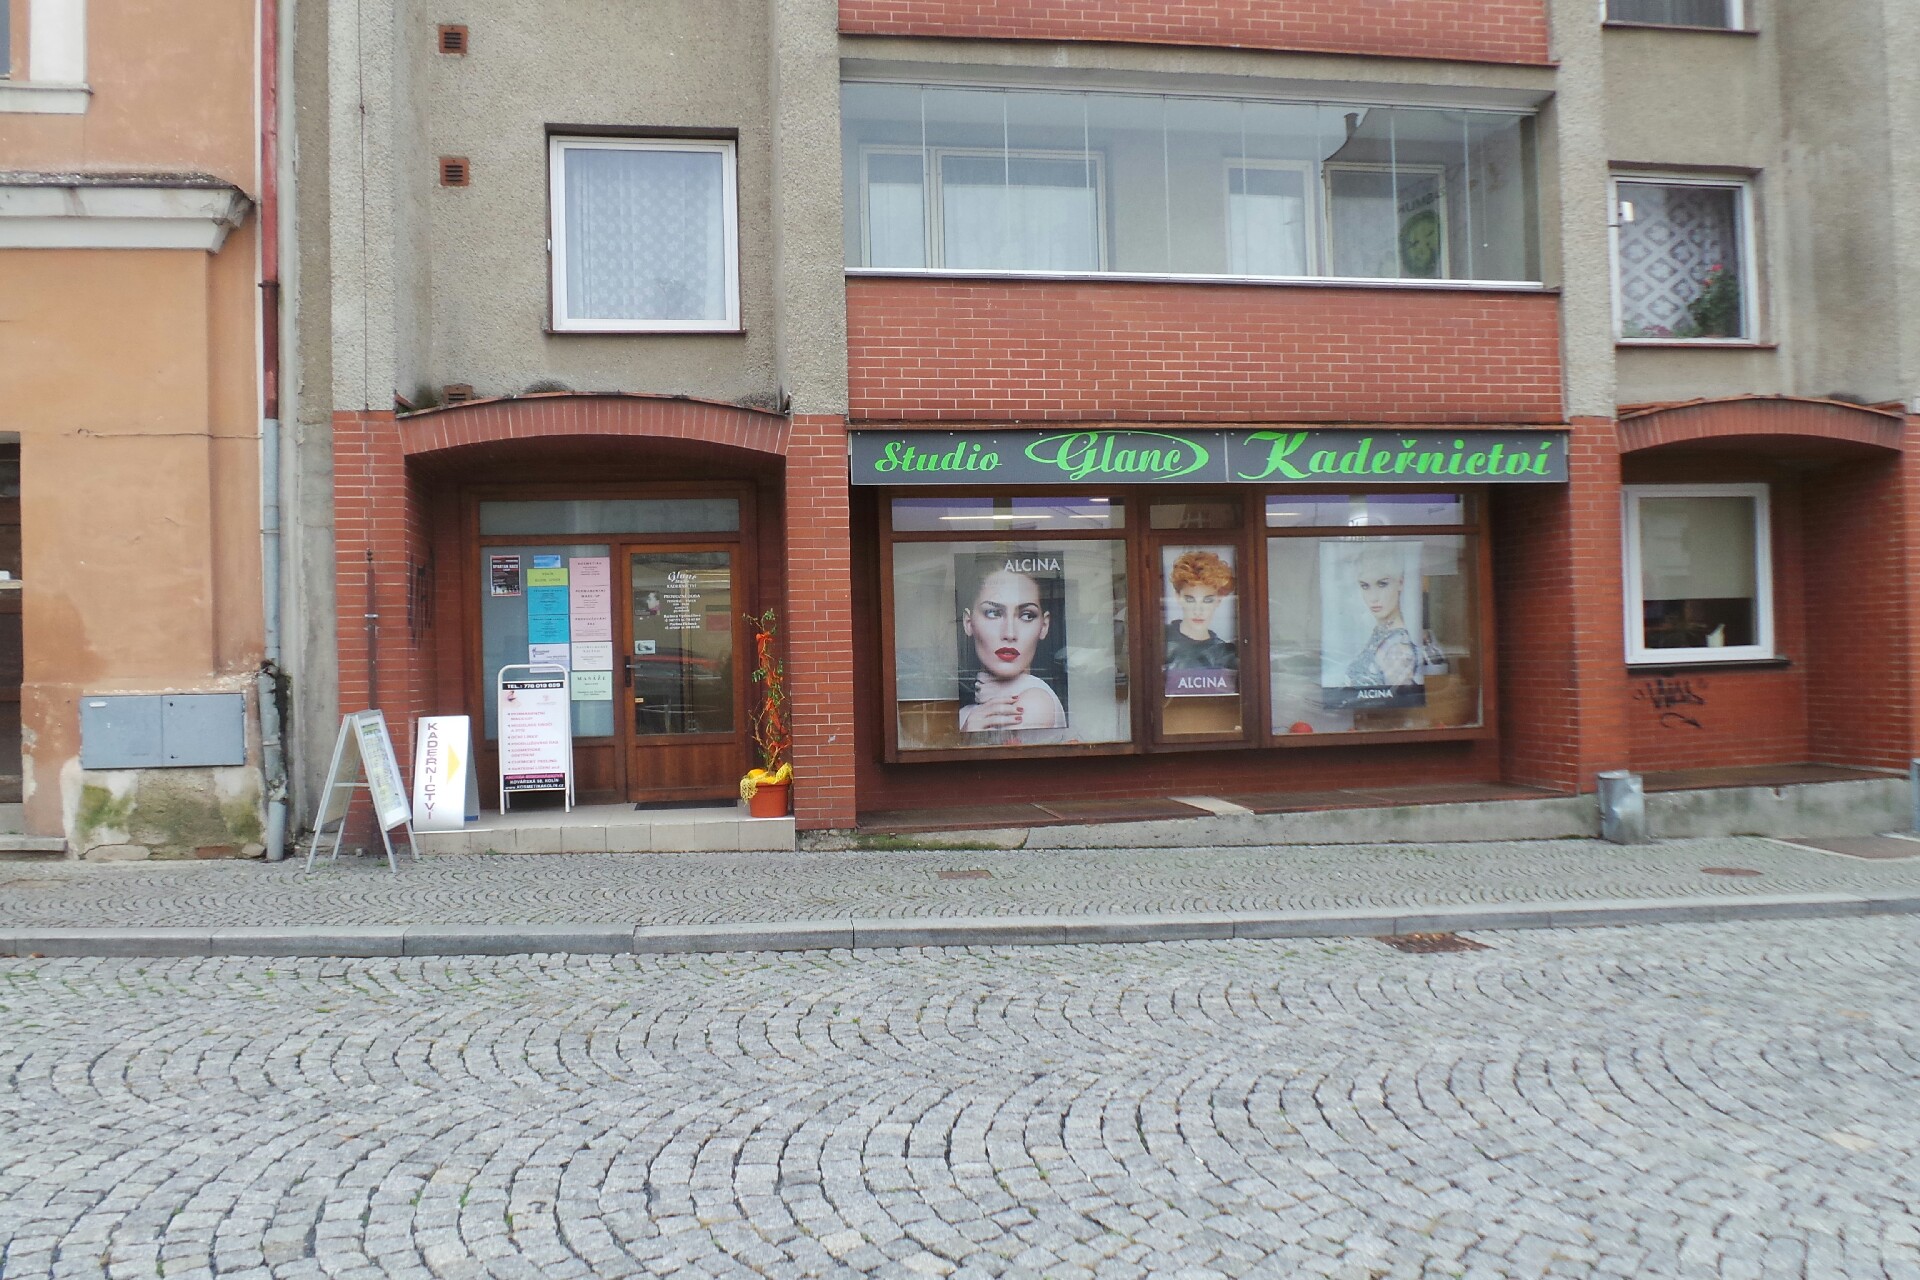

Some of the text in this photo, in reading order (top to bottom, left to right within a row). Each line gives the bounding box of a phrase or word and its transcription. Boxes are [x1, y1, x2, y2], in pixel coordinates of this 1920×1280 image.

[874, 431, 1552, 481] Studio Glanc Kadeřnictví
[1004, 558, 1061, 572] ALCINA
[1178, 677, 1228, 689] ALCINA
[1357, 689, 1393, 699] ALCINA
